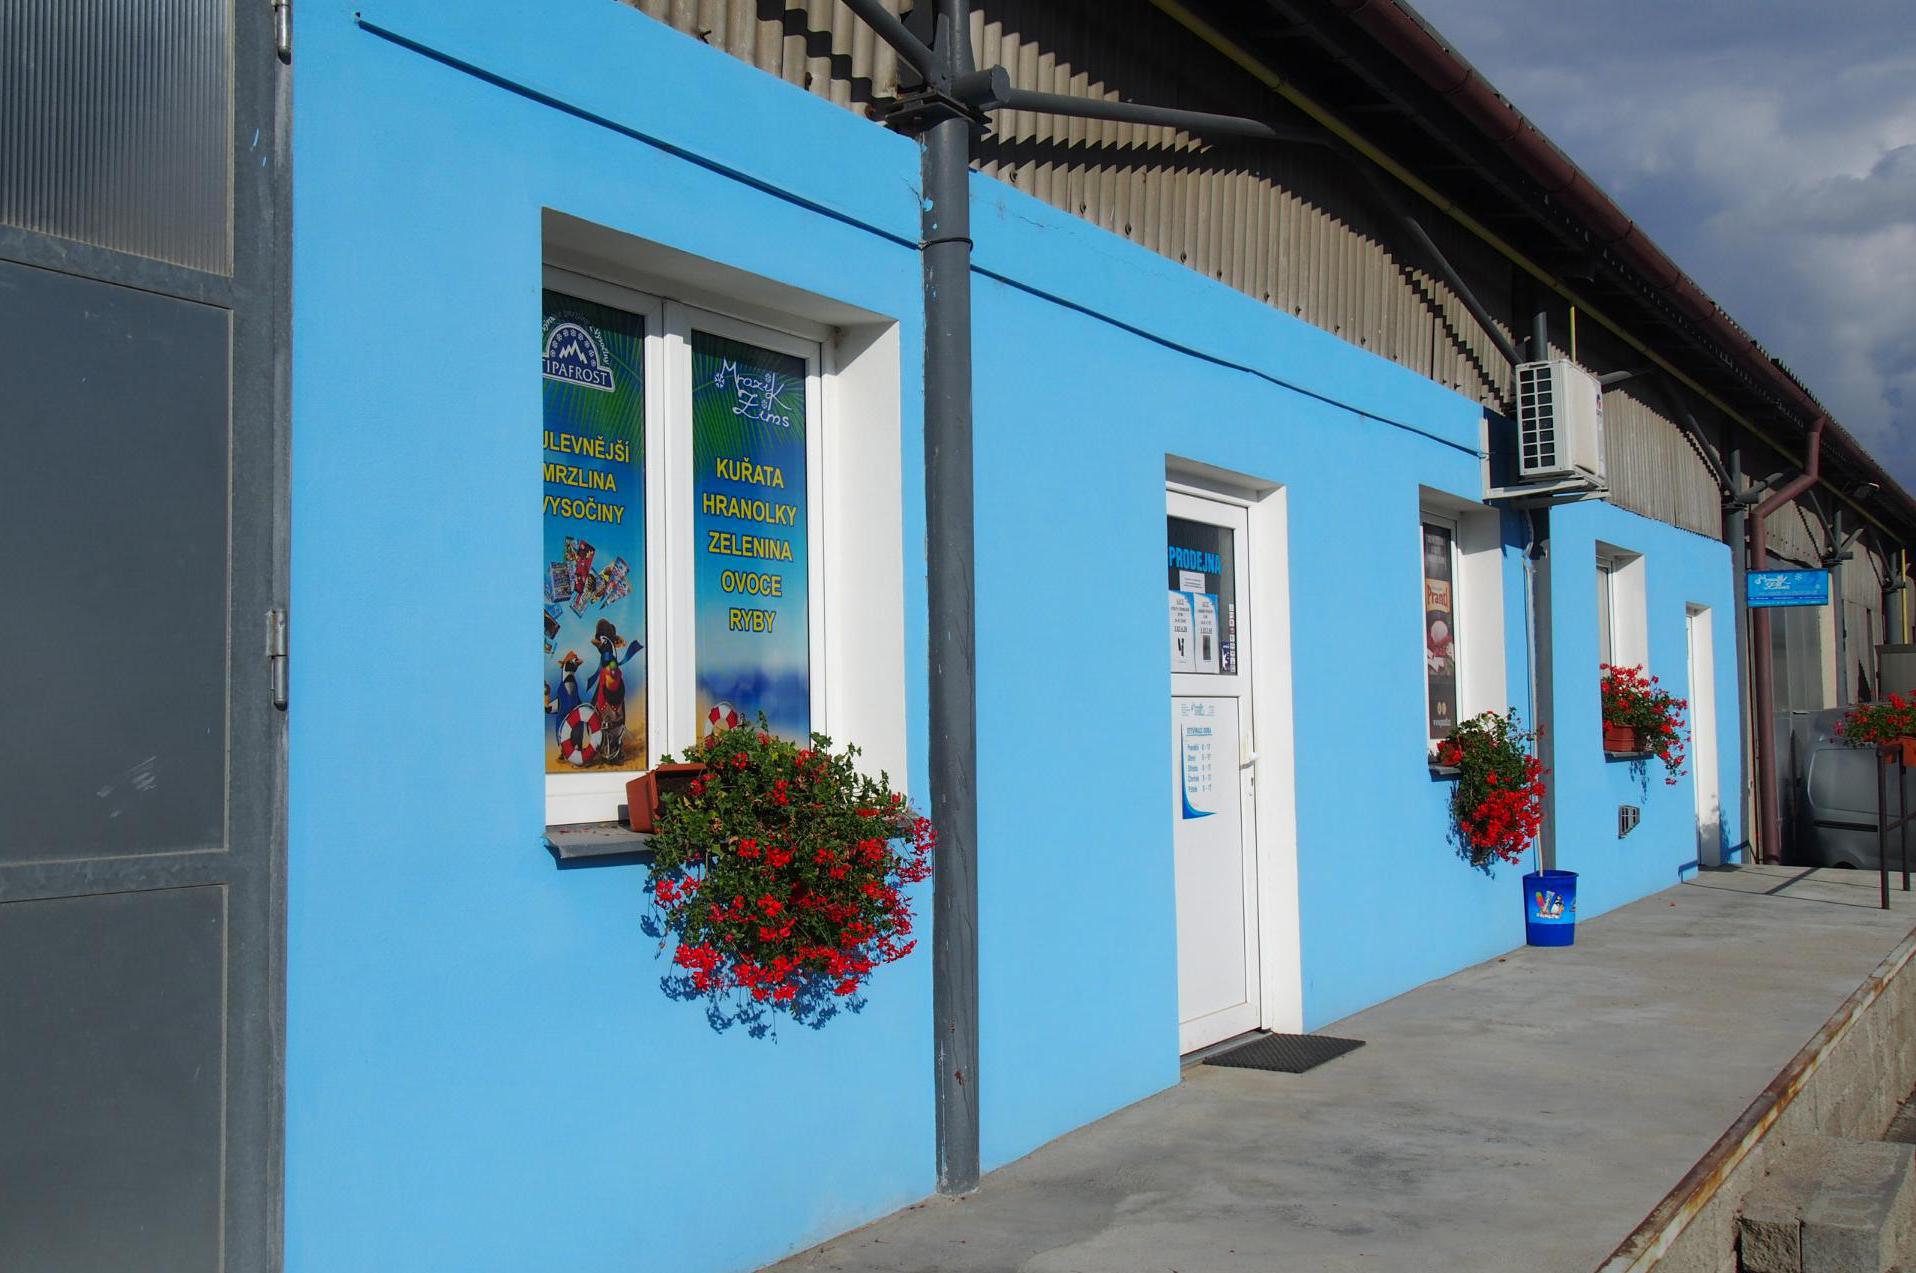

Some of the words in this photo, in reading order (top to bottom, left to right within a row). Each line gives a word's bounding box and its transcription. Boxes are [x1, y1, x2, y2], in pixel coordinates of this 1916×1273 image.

[716, 457, 784, 489] KUŘATA
[702, 492, 798, 526] HRANOLKY
[708, 531, 793, 562] ZELENINA
[1168, 545, 1222, 576] PRODEJNA
[722, 570, 782, 597] OVOCE
[729, 608, 777, 633] RYBY
